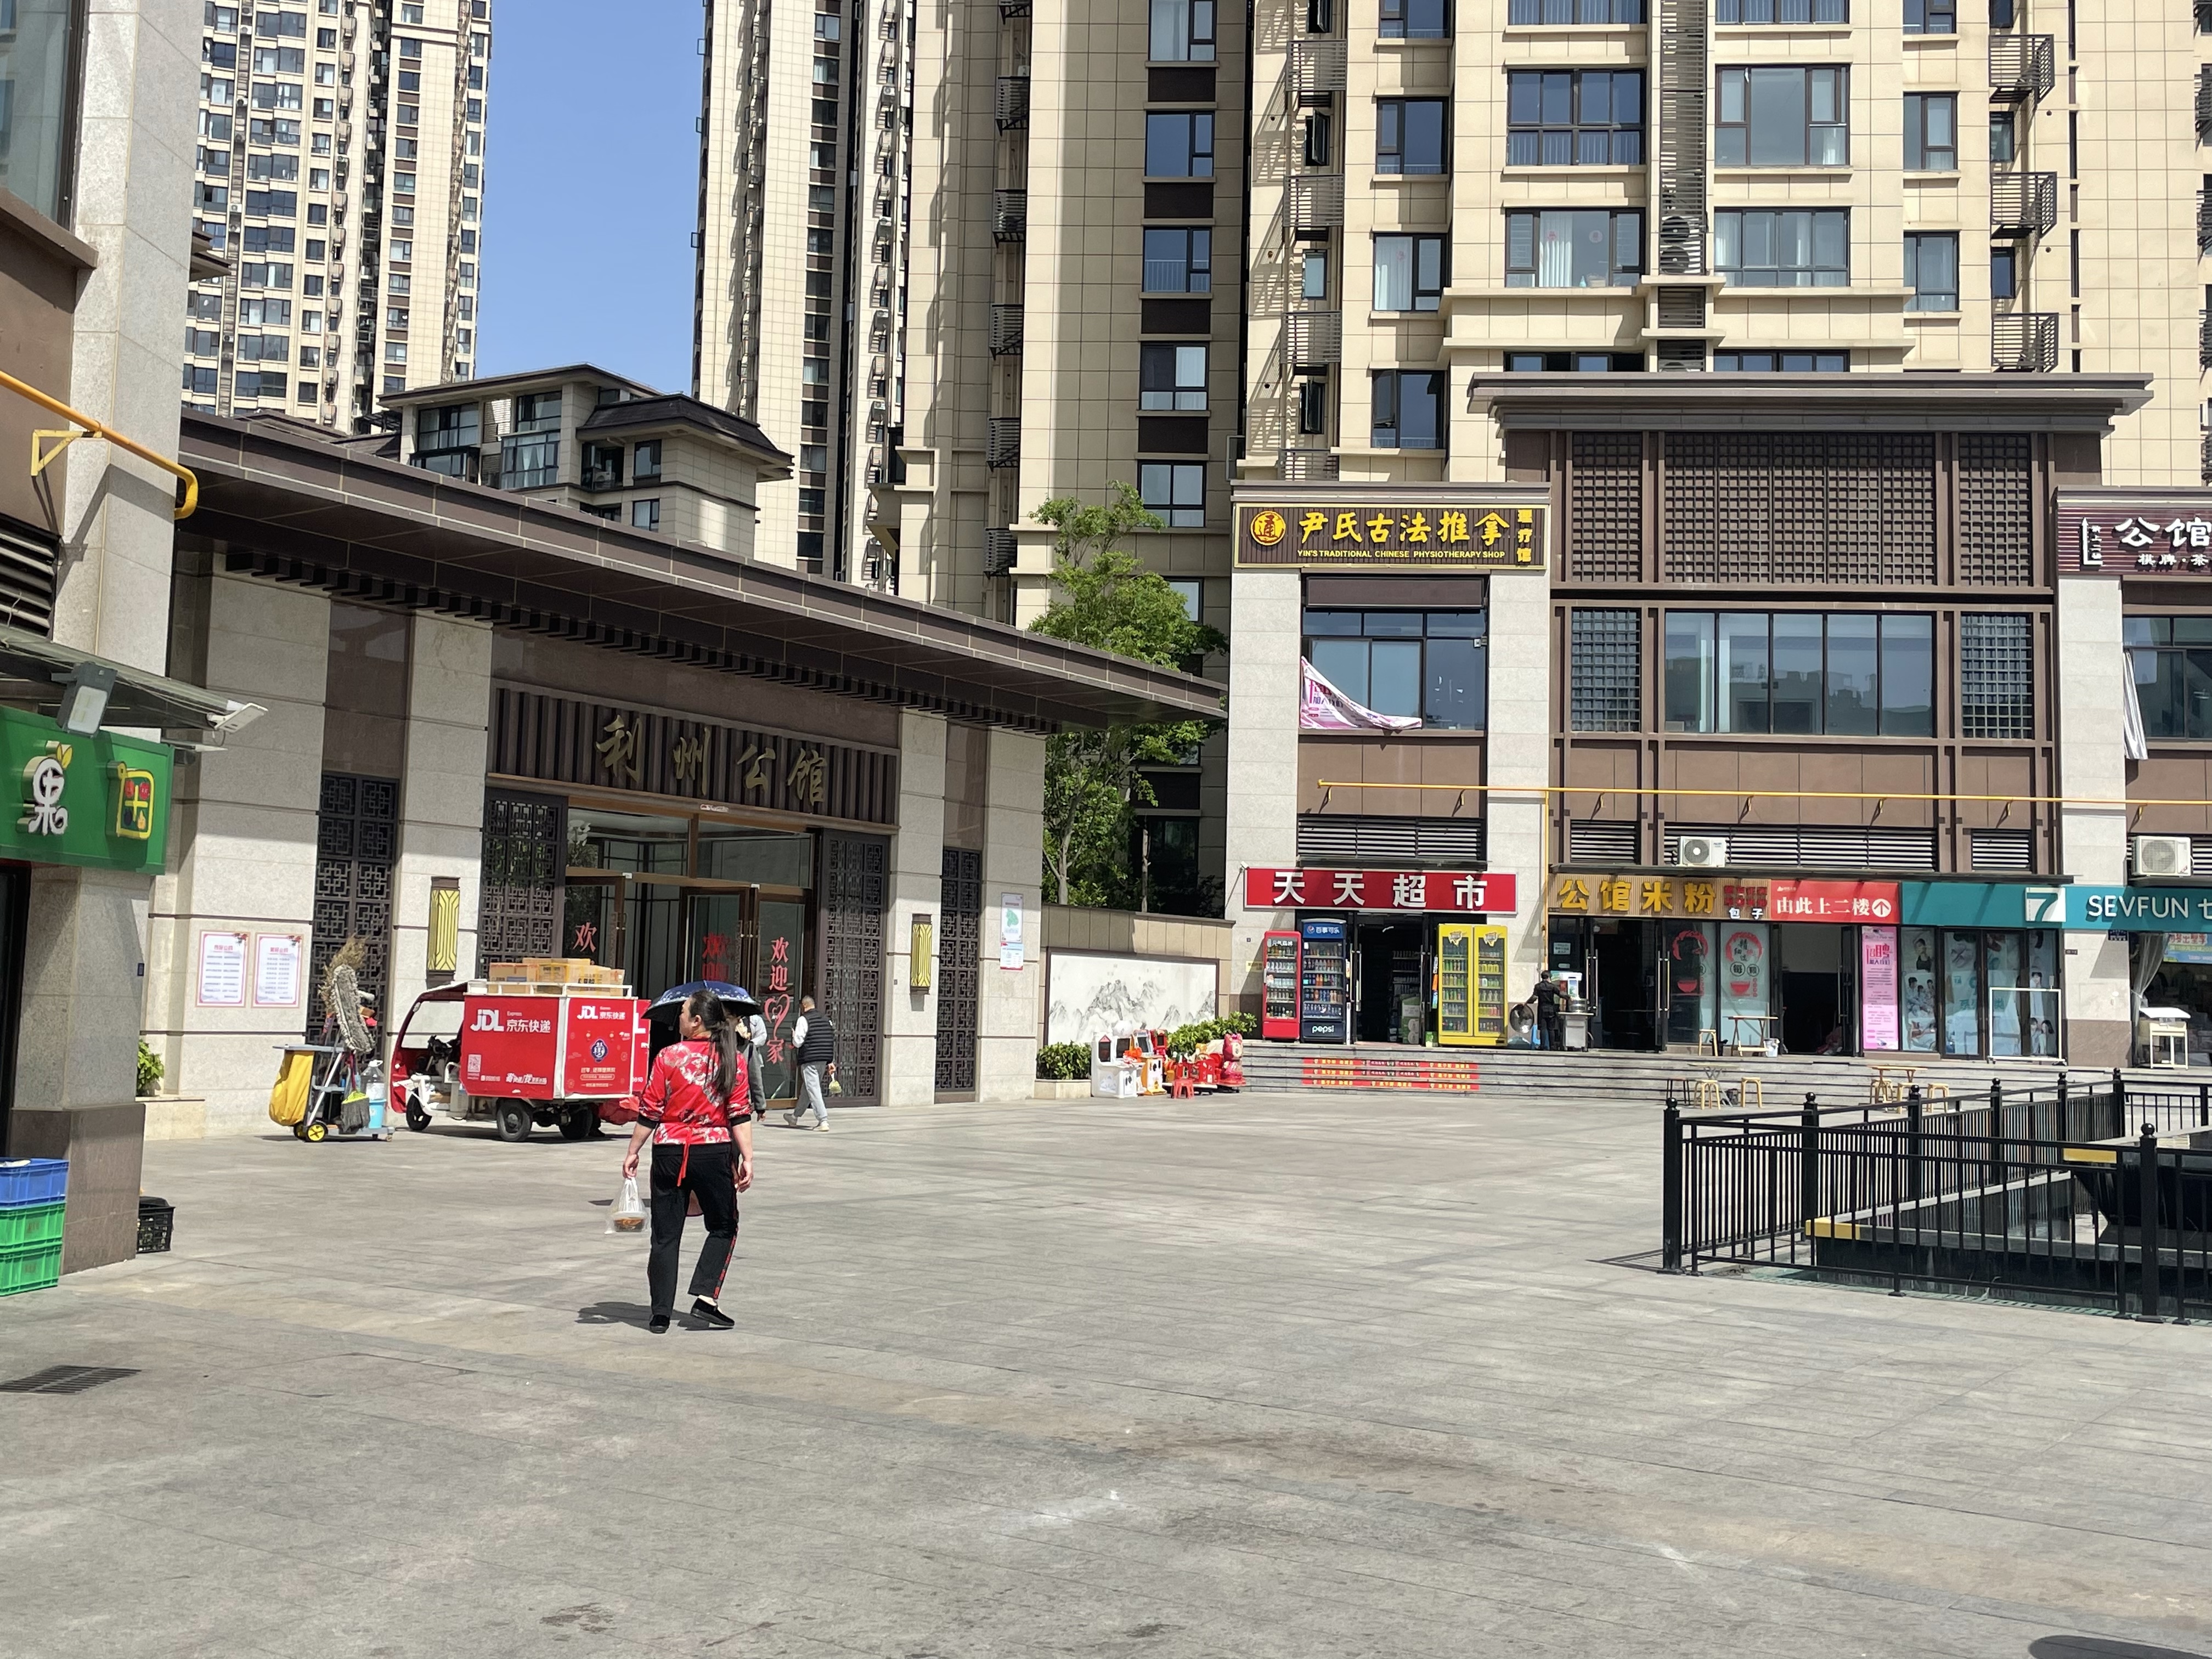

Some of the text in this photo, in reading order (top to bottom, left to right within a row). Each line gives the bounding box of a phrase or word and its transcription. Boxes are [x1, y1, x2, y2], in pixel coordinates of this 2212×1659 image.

[1299, 510, 1510, 546] 尹氏古法推拿
[2115, 516, 2212, 548] 公馆
[596, 714, 827, 806] 利州公馆
[1273, 871, 1488, 910] 天天超市
[1558, 879, 1716, 913] 公馆米粉
[1729, 907, 1764, 920] 包子
[1777, 896, 1870, 916] 由此上二楼
[2088, 895, 2188, 918] SEVFUN
[769, 936, 791, 991] 欢迎
[470, 1009, 504, 1031] JDL
[577, 1006, 599, 1019] JDL
[506, 1019, 551, 1034] 京东快递
[1312, 1025, 1334, 1034] pepsi
[767, 1039, 785, 1064] 家
